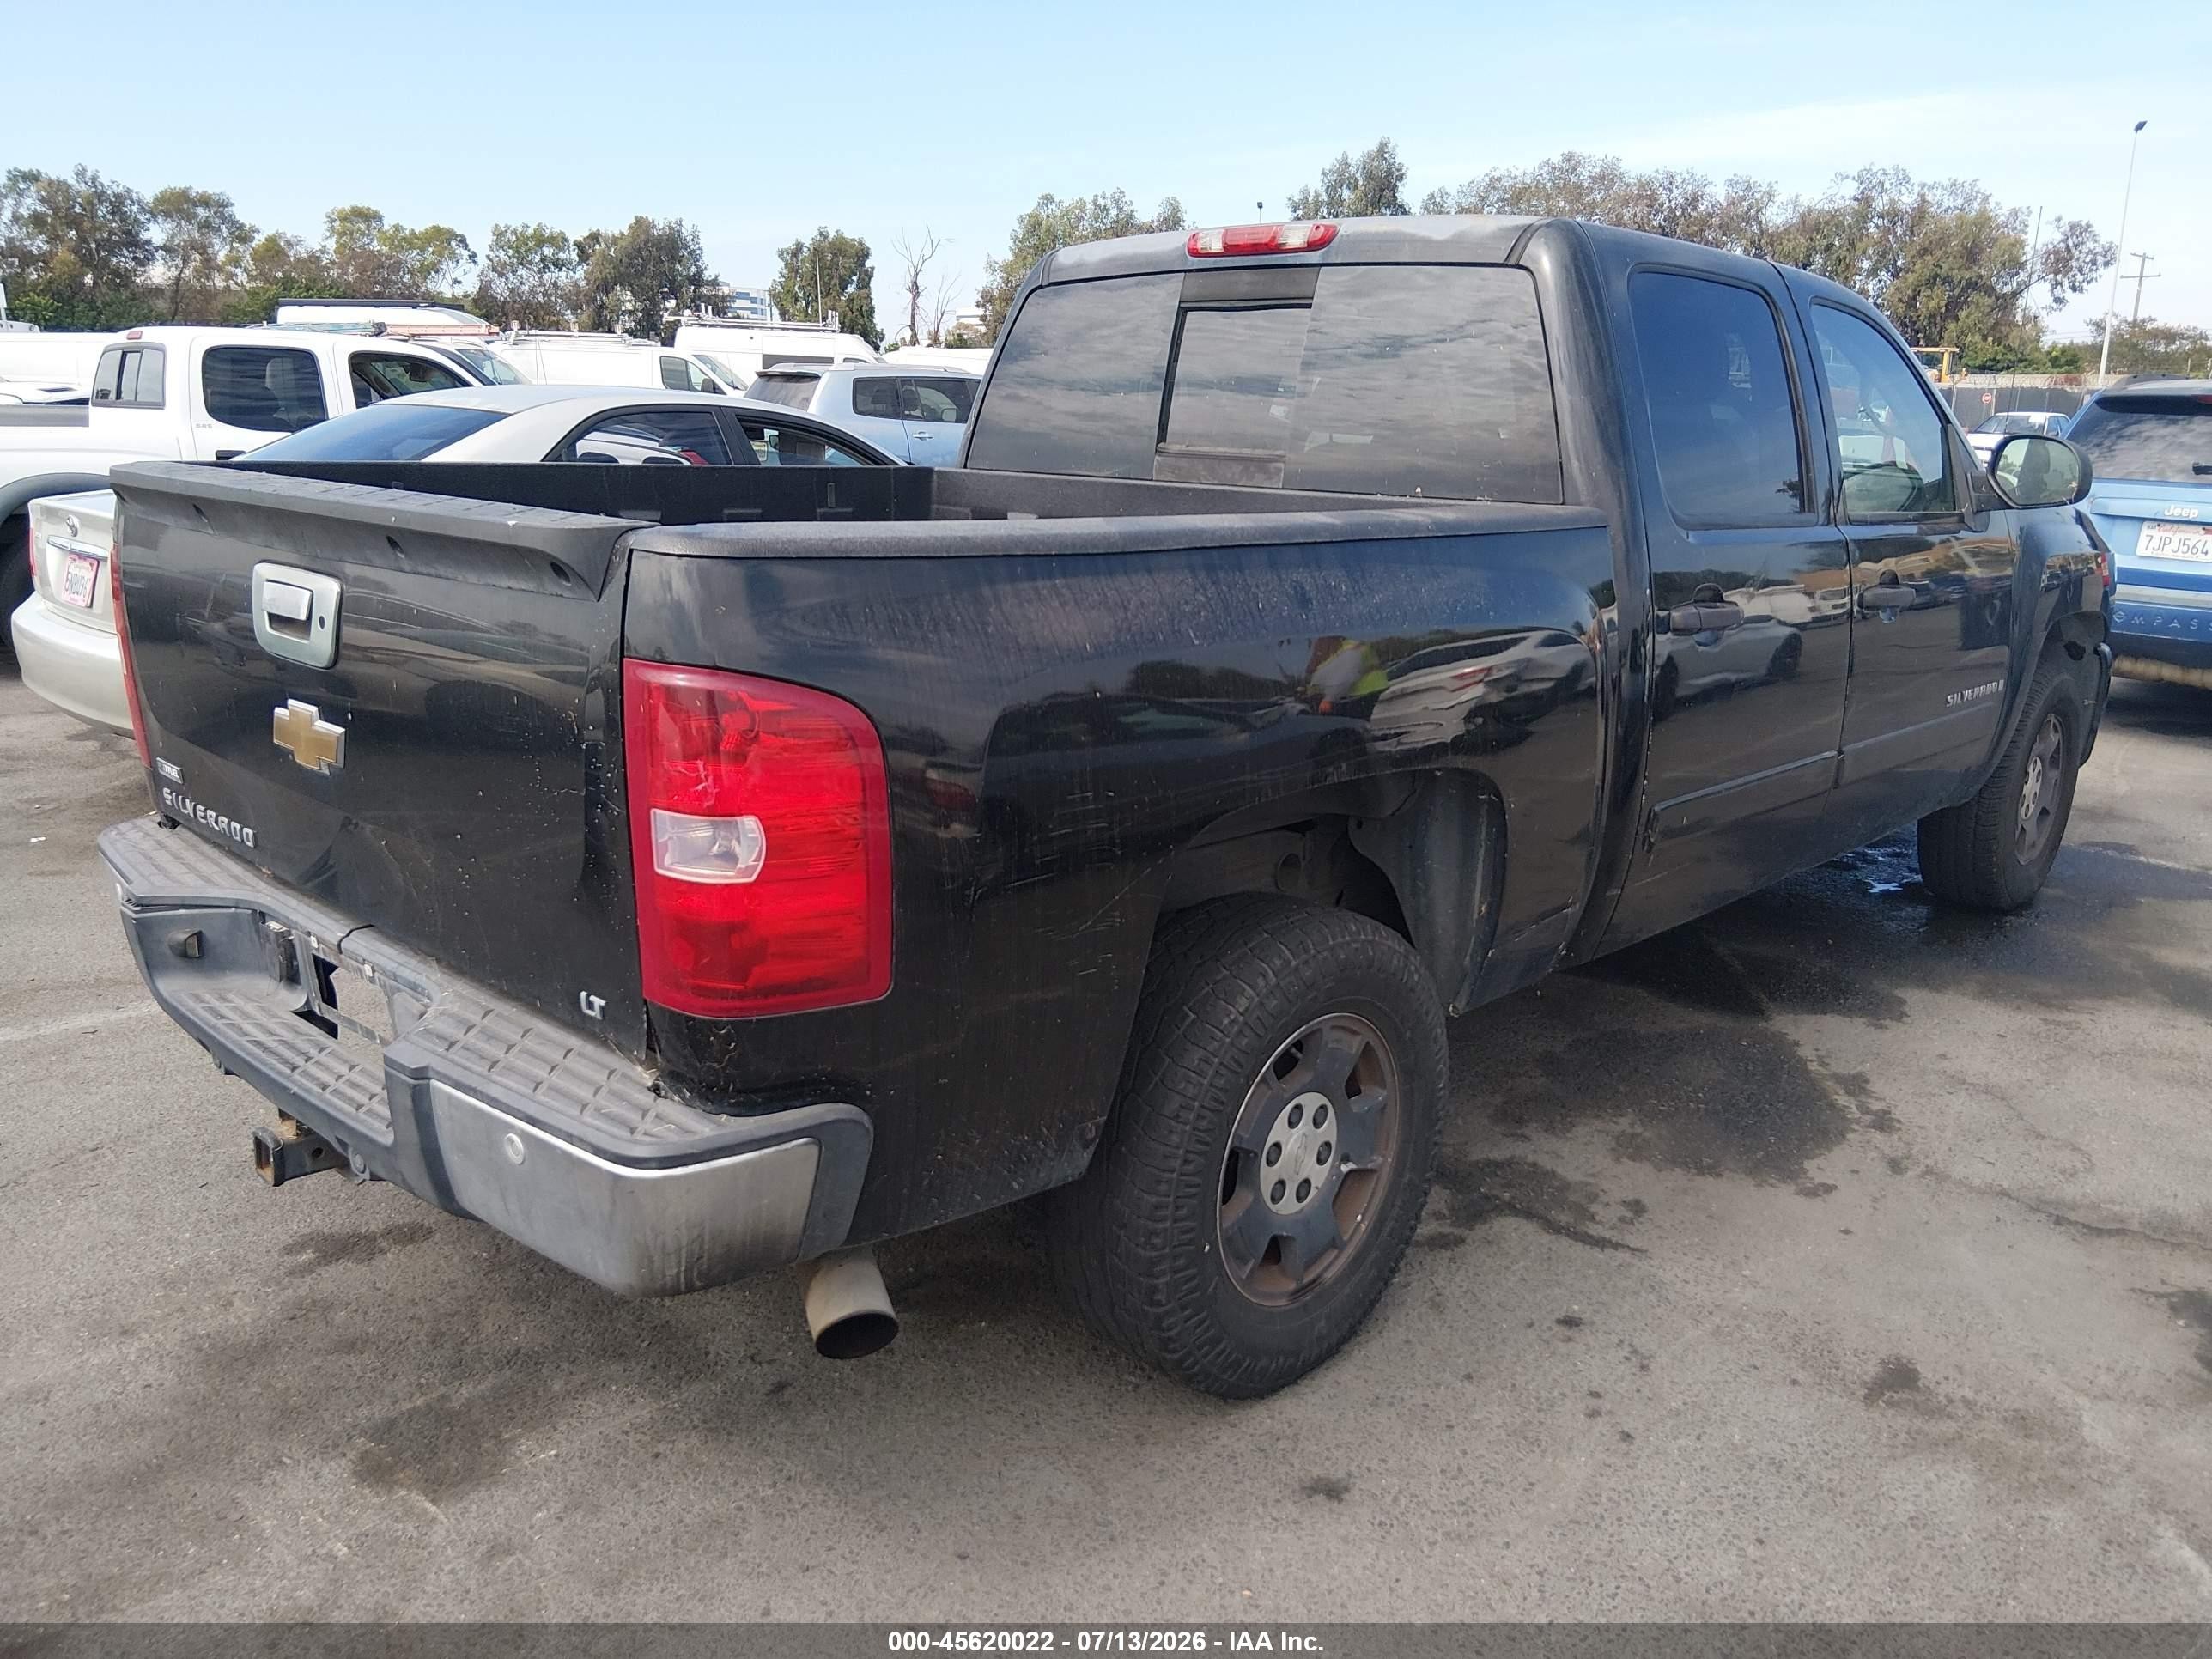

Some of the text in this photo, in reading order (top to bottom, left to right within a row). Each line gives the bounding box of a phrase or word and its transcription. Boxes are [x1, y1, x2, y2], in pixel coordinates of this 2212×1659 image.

[2165, 505, 2199, 519] Jeep
[2145, 534, 2209, 556] 7JPJ564
[2112, 611, 2212, 631] OMPAS
[1946, 681, 1998, 708] SILVERADO
[163, 787, 255, 848] SILVERADO
[580, 990, 606, 1020] LT
